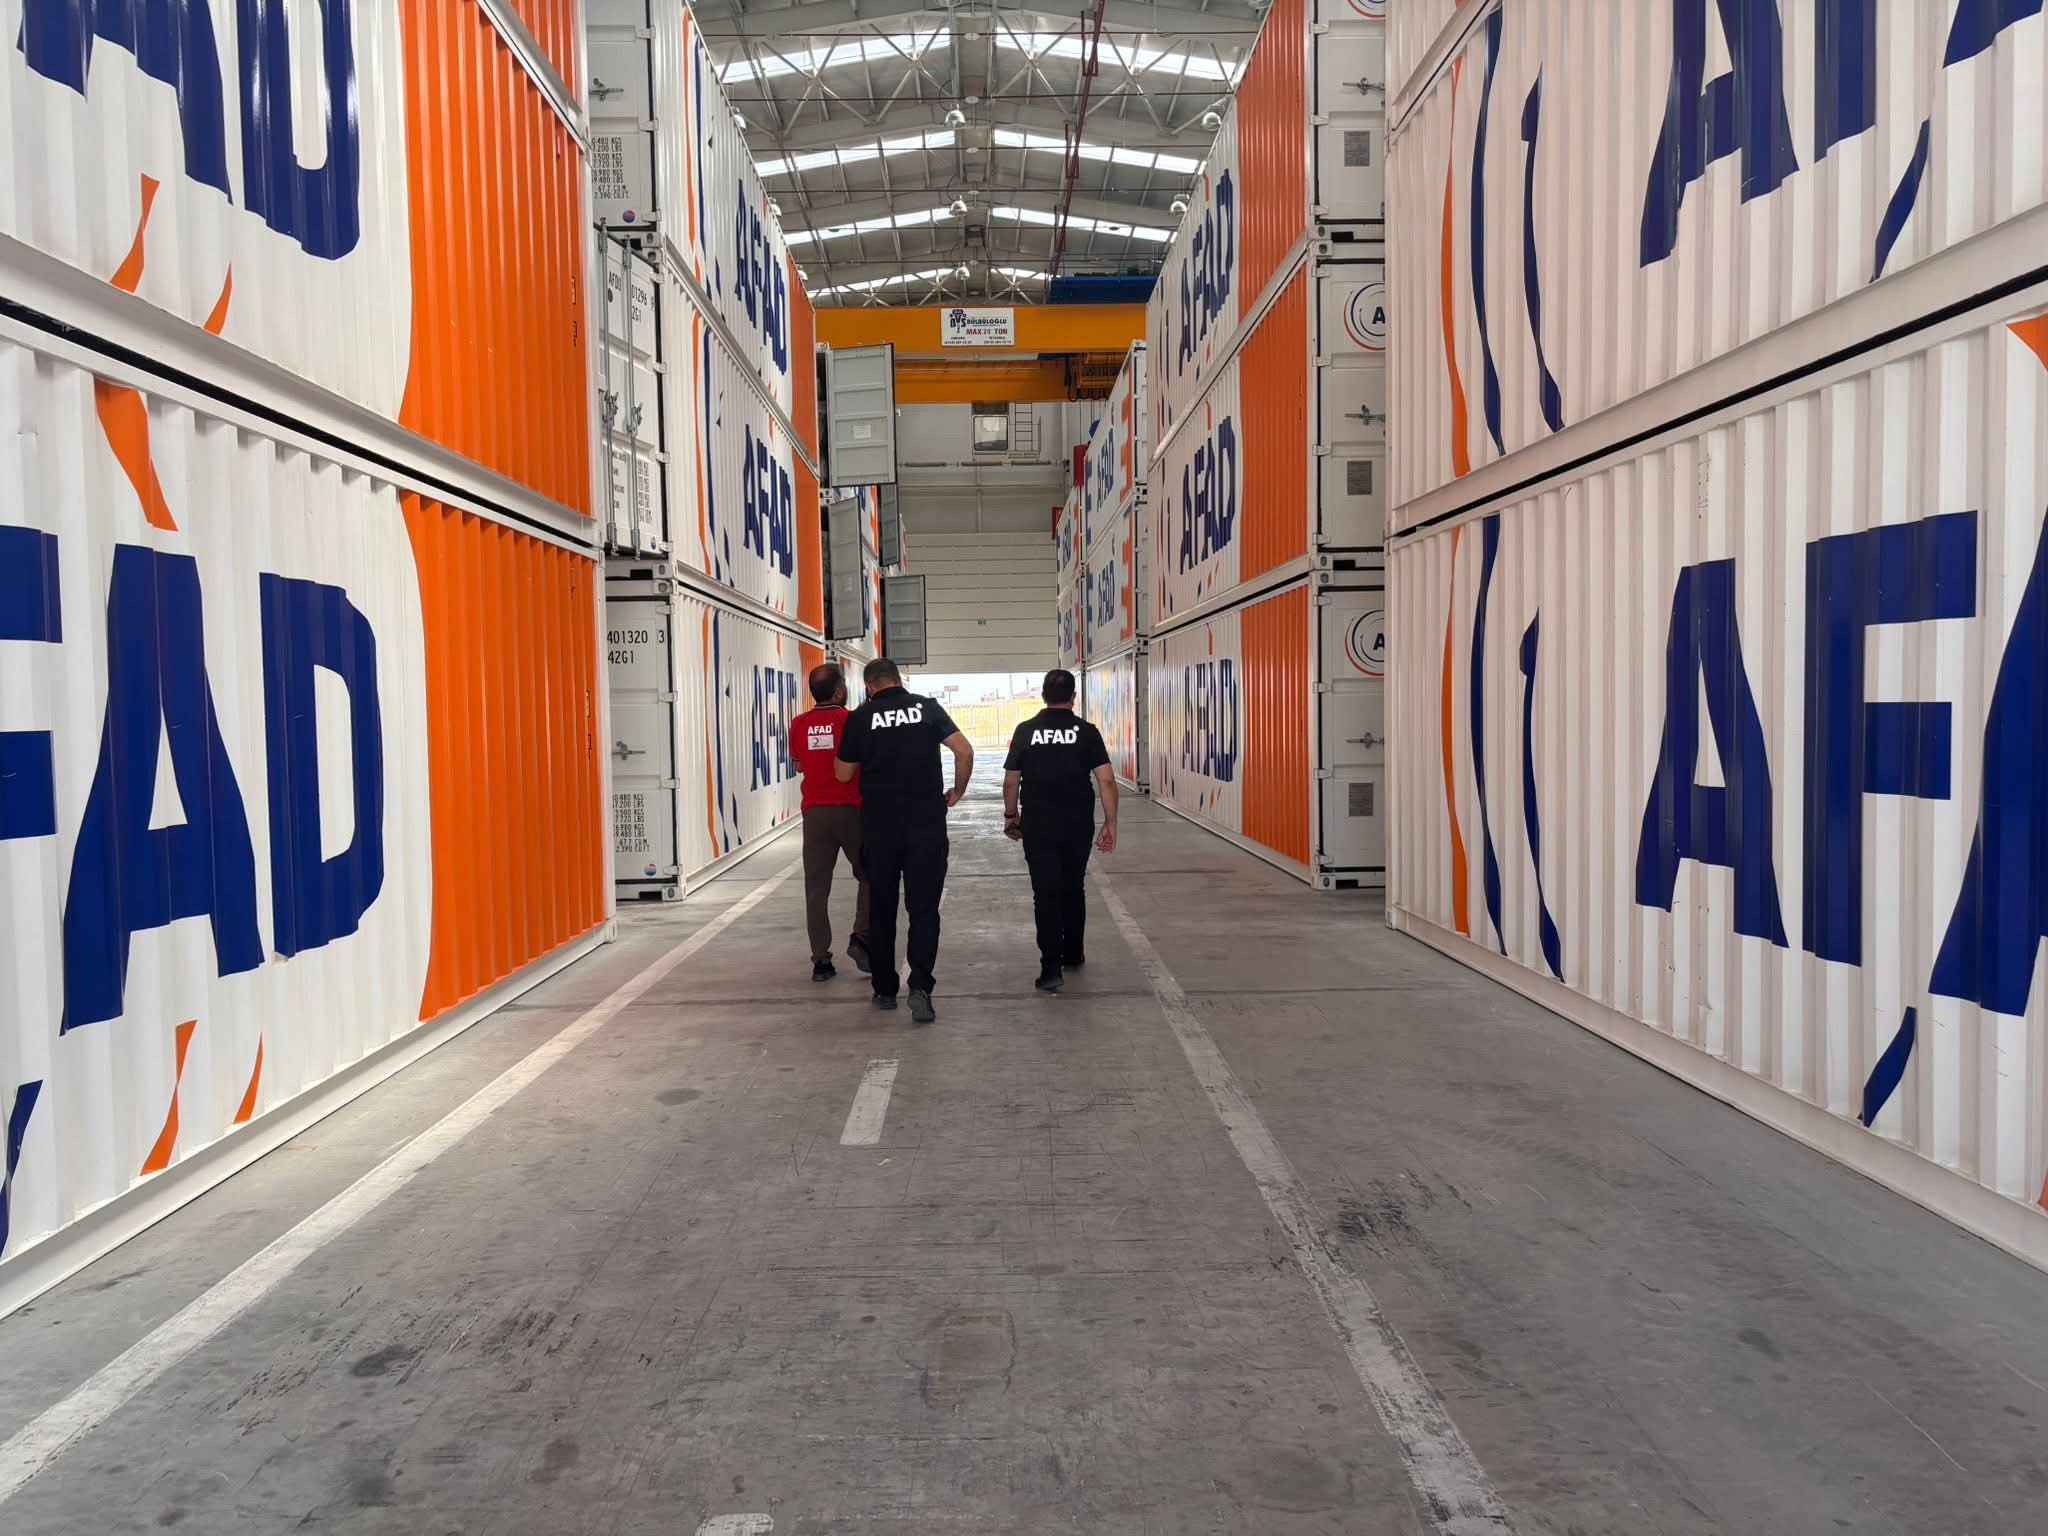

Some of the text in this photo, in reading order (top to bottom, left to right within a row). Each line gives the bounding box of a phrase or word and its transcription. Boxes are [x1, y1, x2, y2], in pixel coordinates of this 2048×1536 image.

[16, 0, 361, 261] D
[735, 179, 786, 375] AFAD
[1179, 168, 1233, 376] AFAD
[743, 424, 793, 579] AFAD
[1180, 416, 1235, 575] AFAD
[607, 629, 665, 644] 401320 3
[808, 725, 832, 735] AFAD
[871, 707, 922, 730] AFAD
[1030, 729, 1077, 746] AFAD
[1182, 658, 1237, 782] AFAD
